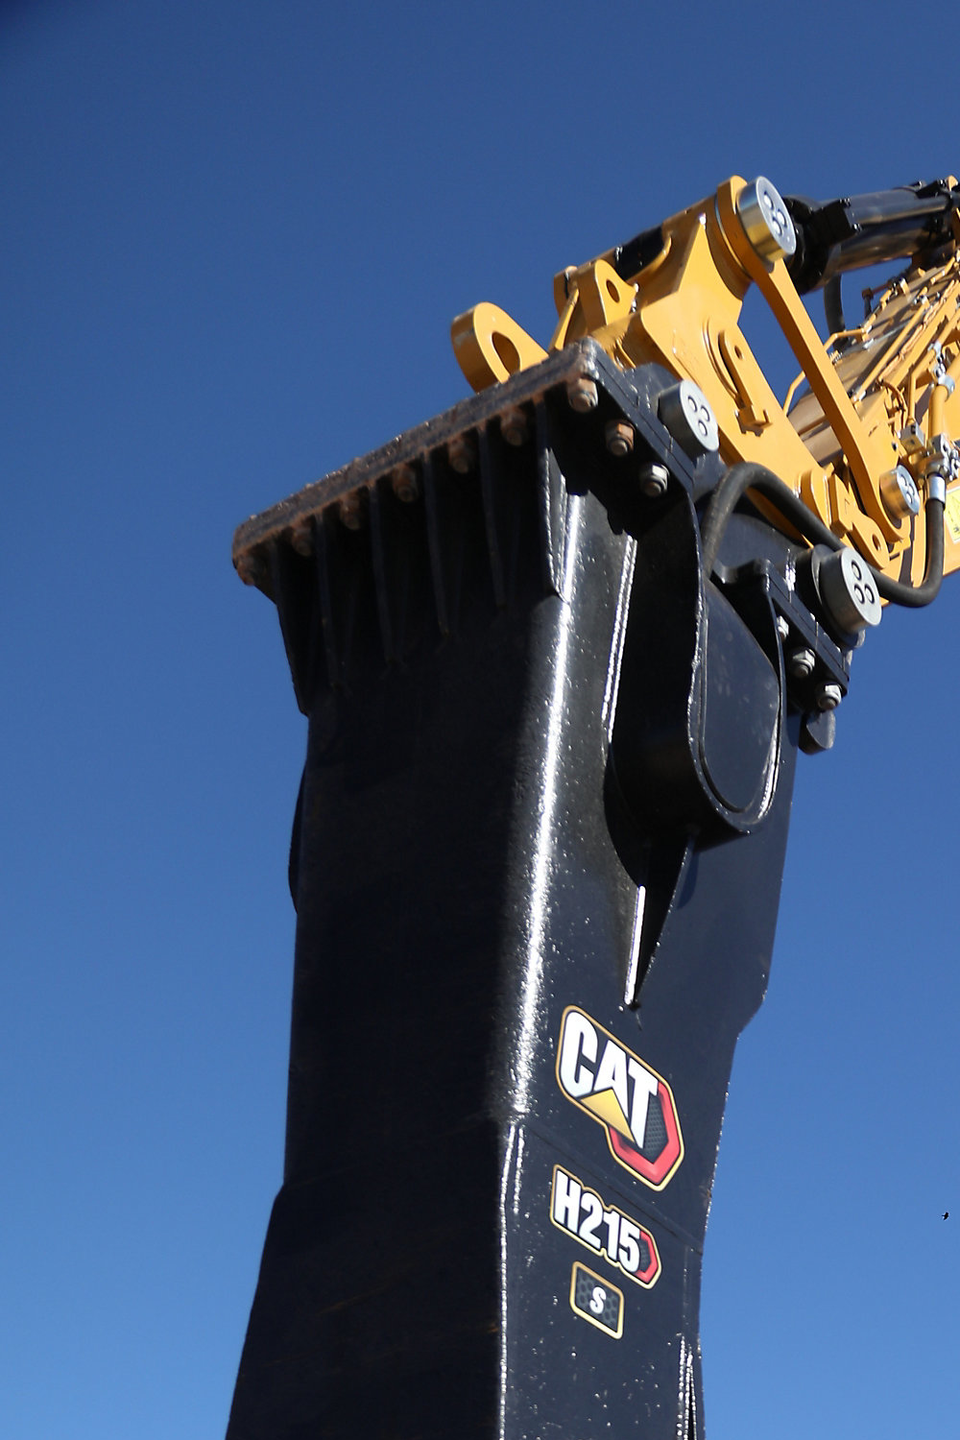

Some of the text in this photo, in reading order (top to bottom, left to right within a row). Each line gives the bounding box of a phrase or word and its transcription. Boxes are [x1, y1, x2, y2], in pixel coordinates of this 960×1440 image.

[560, 1011, 660, 1149] CAT
[554, 1170, 642, 1274] H215
[590, 1286, 607, 1314] S
